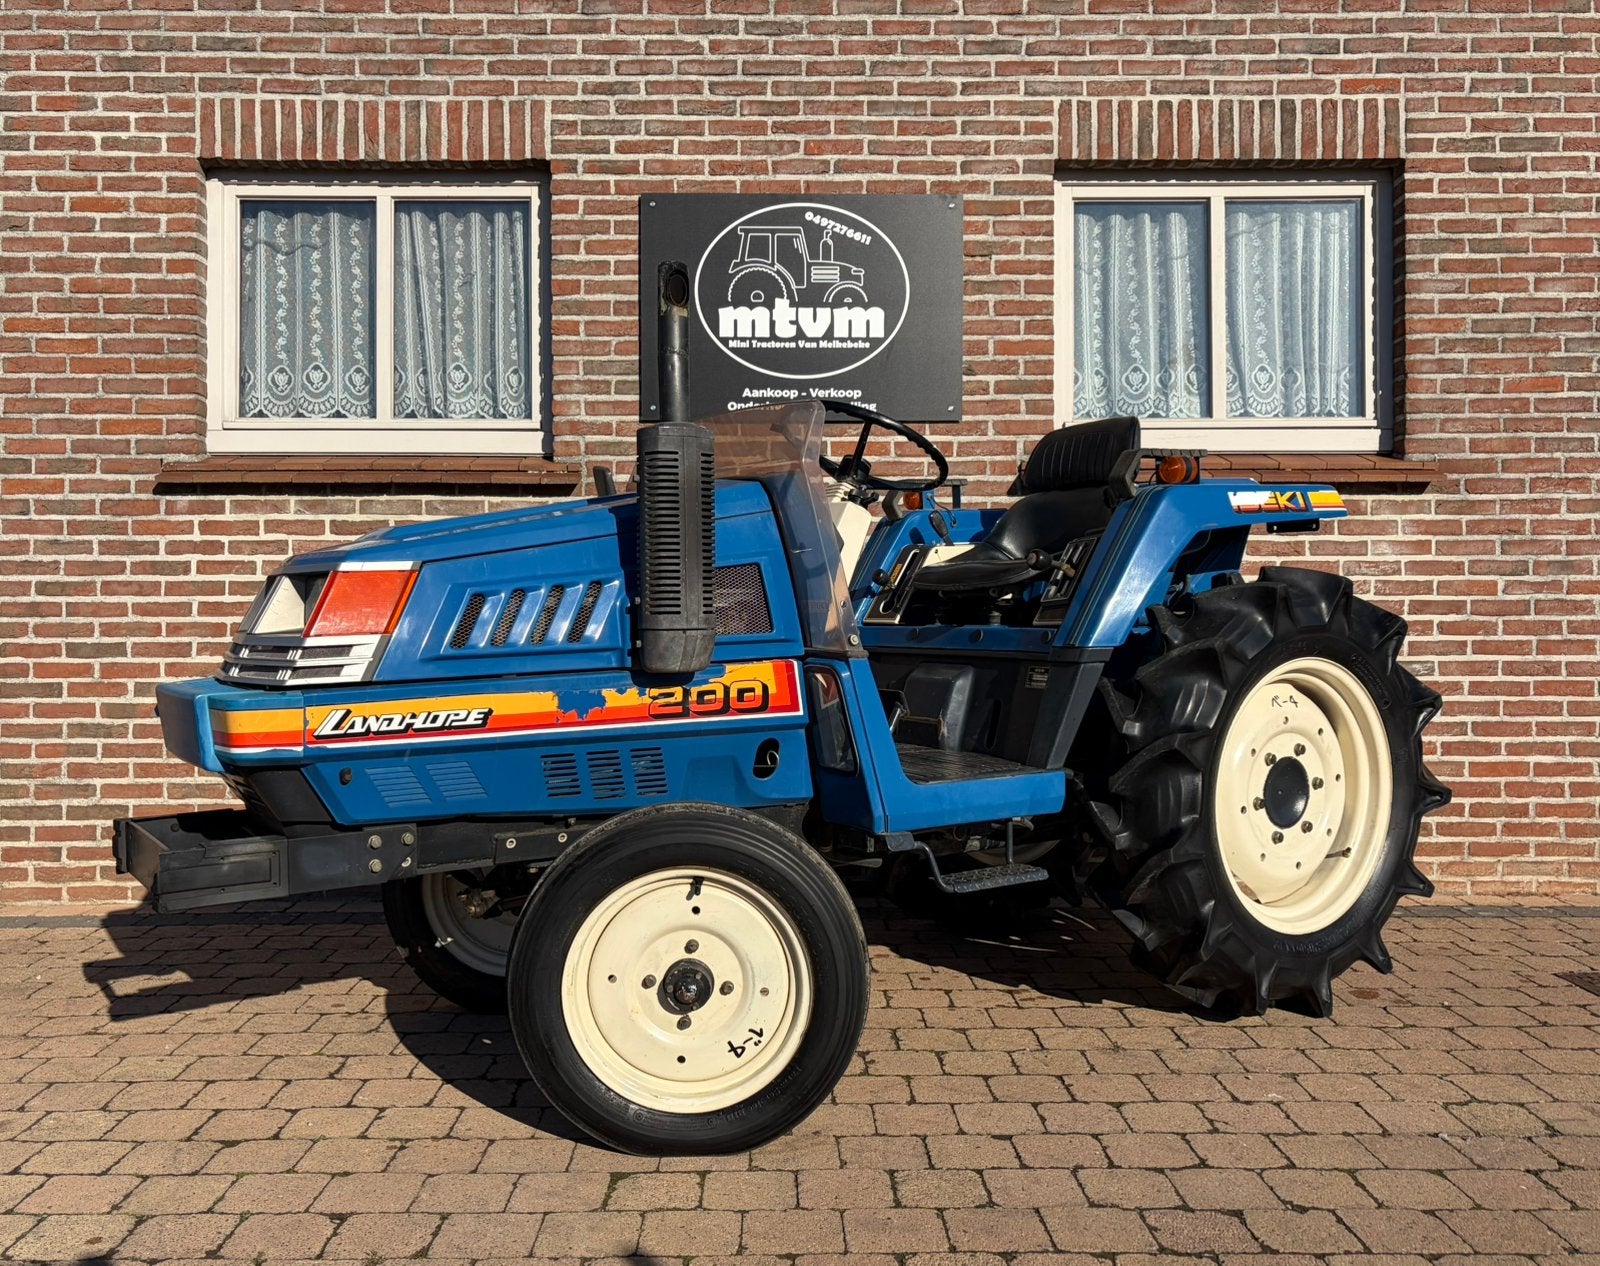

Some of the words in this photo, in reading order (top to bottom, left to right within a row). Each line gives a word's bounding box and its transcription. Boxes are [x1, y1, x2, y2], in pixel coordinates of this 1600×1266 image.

[804, 211, 872, 246] 0497276611
[718, 297, 885, 338] mtvm
[728, 339, 750, 348] Mini
[751, 339, 797, 348] Tractoren
[797, 339, 818, 348] Van
[742, 387, 799, 400] Aankoop
[809, 387, 862, 400] Verkoop
[648, 679, 770, 719] 200
